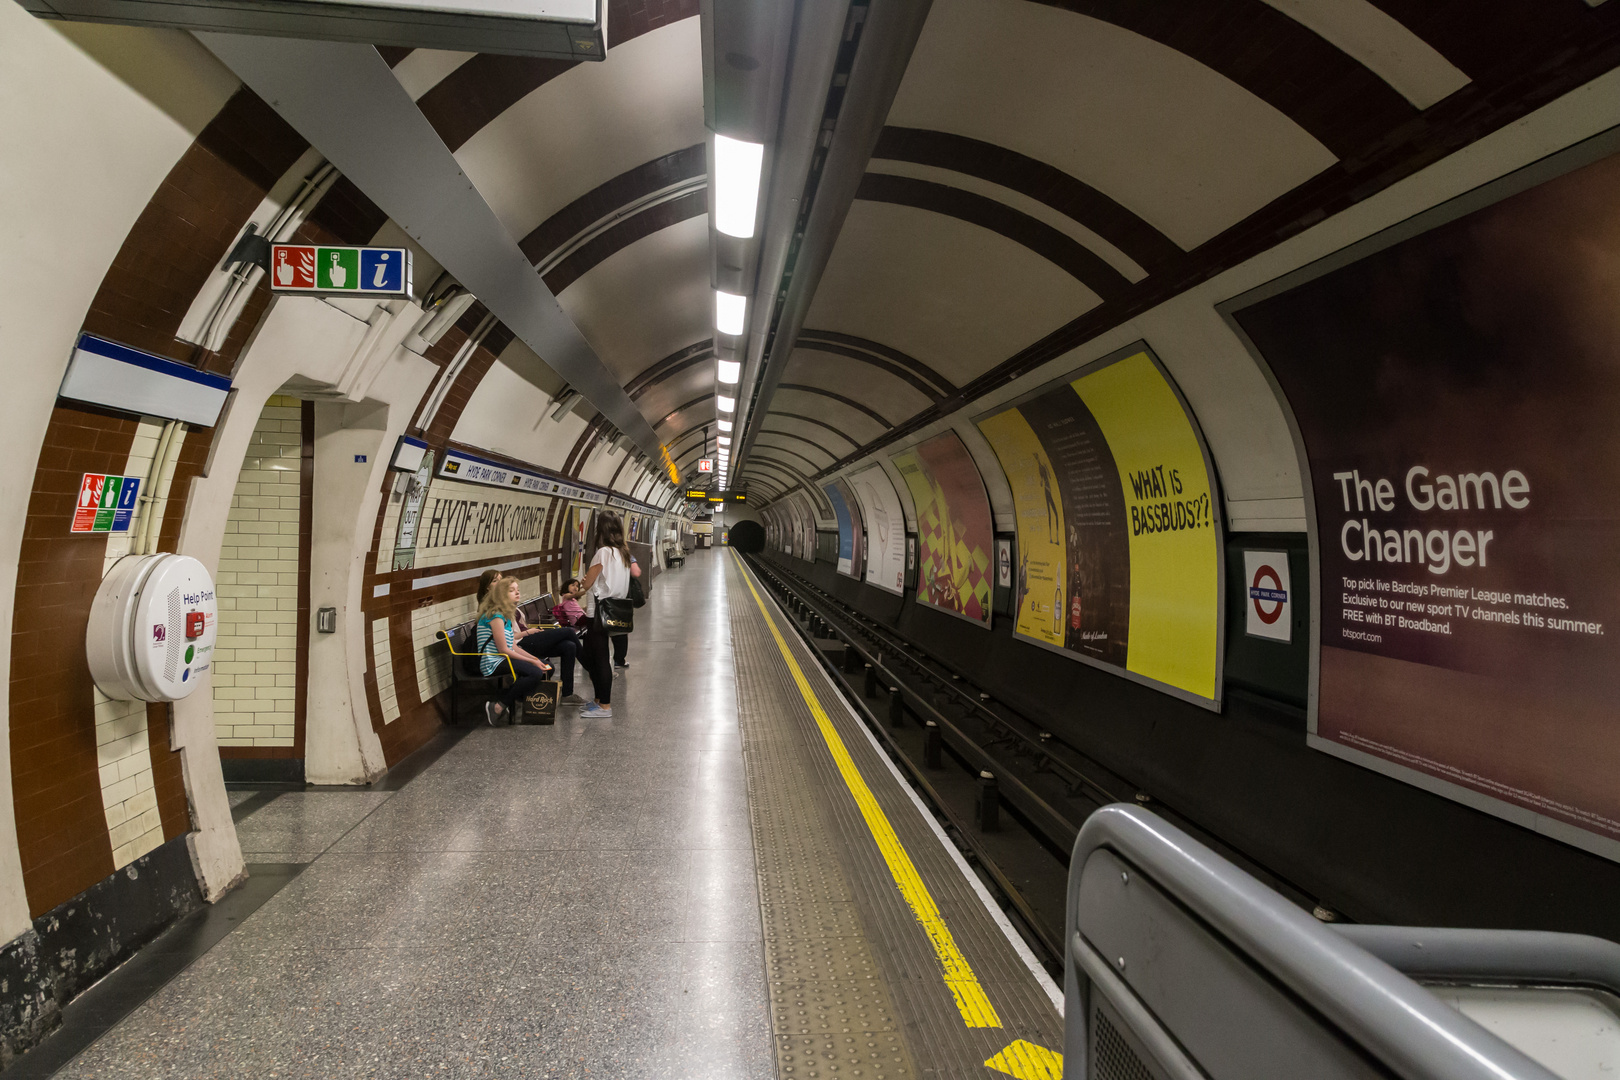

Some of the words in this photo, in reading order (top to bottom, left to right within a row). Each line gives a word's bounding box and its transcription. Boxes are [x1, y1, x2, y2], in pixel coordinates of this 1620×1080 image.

[466, 465, 481, 479] HYDE
[479, 468, 492, 481] PARK
[491, 471, 507, 484] CORNER
[1129, 465, 1167, 500] WHAT
[1169, 468, 1182, 496] IS
[1334, 470, 1396, 512] The
[1406, 466, 1530, 511] Game
[404, 510, 418, 524] OUT
[426, 499, 477, 548] HYDE
[476, 503, 510, 544] PARK
[510, 506, 546, 540] CORNER
[1131, 492, 1209, 536] BASSBUDS??
[1341, 520, 1494, 575] Changer
[184, 594, 200, 606] Help
[201, 590, 214, 602] Point
[1342, 576, 1357, 590] Top
[1358, 578, 1374, 592] pick
[1376, 580, 1390, 592] live
[1392, 582, 1428, 596] Barclays
[1430, 585, 1469, 600] Premier
[1472, 586, 1512, 605] League
[1514, 592, 1568, 609] matches.
[1342, 593, 1378, 608] Exclusive
[1379, 598, 1388, 608] to
[1390, 600, 1404, 610] our
[1406, 602, 1425, 612] new
[1427, 602, 1452, 618] sport
[1454, 605, 1470, 618] TV
[1472, 607, 1520, 624] channels
[1522, 612, 1544, 627] this
[1547, 618, 1604, 636] summer.
[1342, 610, 1364, 622] FREE
[1366, 612, 1382, 625] with
[1384, 614, 1396, 626] BT
[1398, 616, 1452, 635] Broadband.
[1342, 627, 1382, 644] btsport.com
[540, 696, 553, 704] Rock
